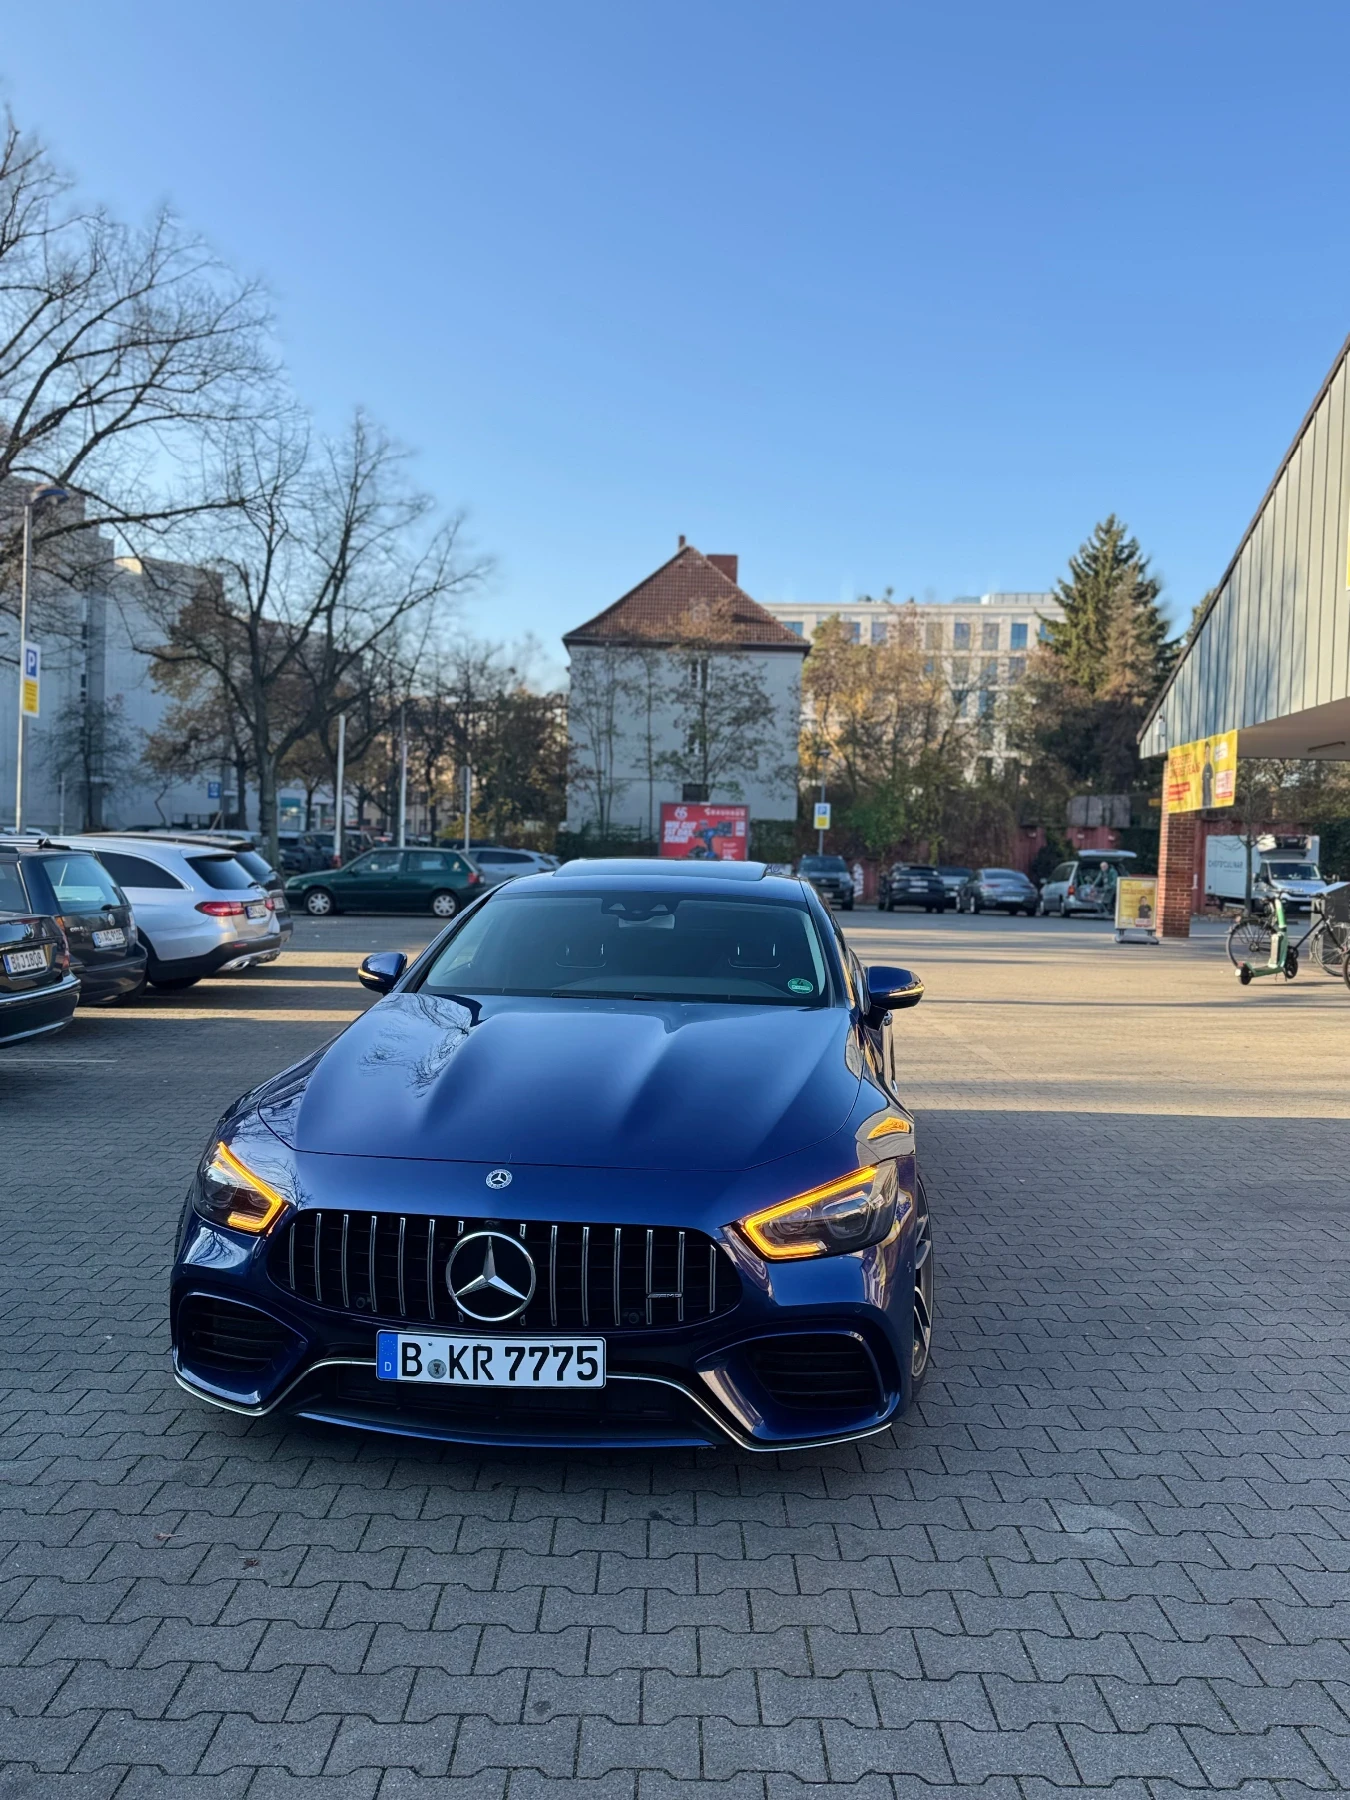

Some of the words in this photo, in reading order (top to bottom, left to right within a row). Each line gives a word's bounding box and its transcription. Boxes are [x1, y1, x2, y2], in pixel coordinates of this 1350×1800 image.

[27, 651, 36, 674] P
[384, 1361, 392, 1372] D
[401, 1342, 422, 1377] B
[449, 1344, 495, 1380] KR
[504, 1346, 598, 1382] 7775
